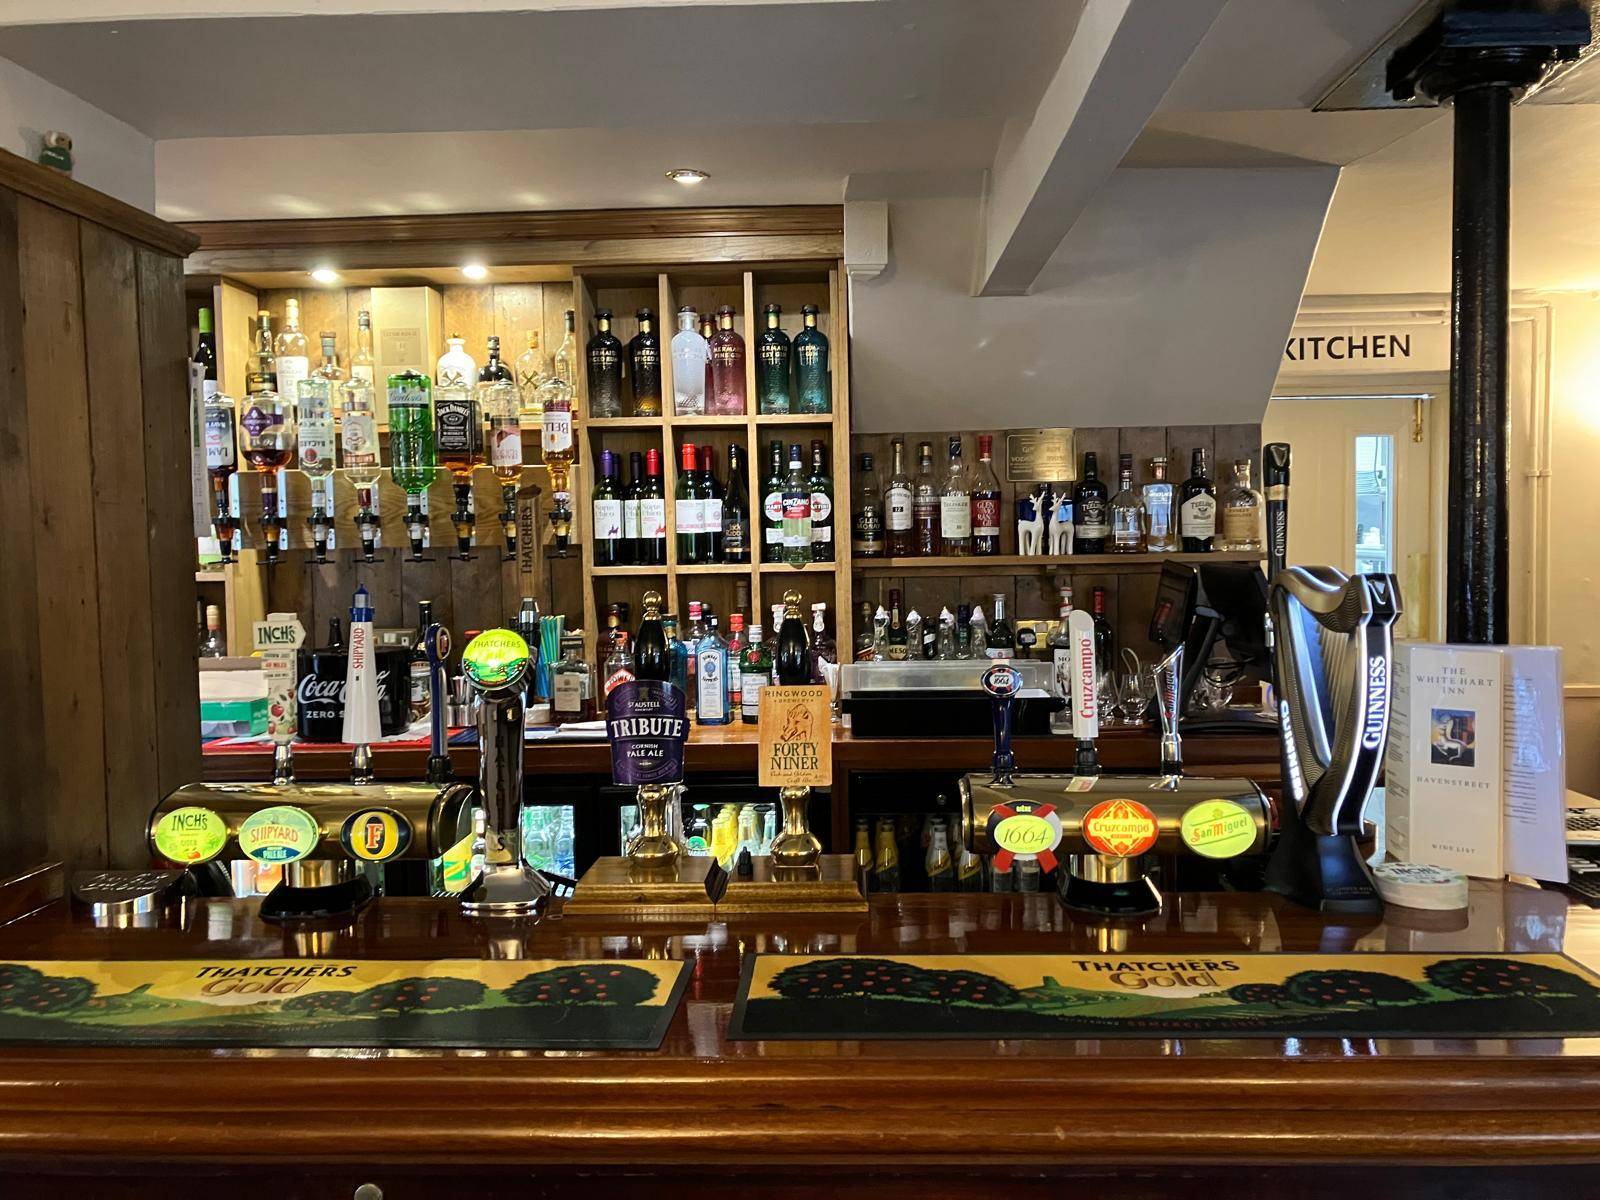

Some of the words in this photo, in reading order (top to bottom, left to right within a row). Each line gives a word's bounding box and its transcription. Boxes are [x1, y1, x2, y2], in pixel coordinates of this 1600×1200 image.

[1285, 334, 1410, 360] KITCHEN
[782, 498, 809, 506] CINZANO
[976, 501, 995, 509] GLEN
[521, 506, 533, 575] THATCHERS
[1274, 510, 1285, 557] GUINNESS
[353, 627, 365, 670] SHIPYARD
[473, 639, 521, 649] THATCHERS
[1441, 666, 1467, 676] THE
[1080, 639, 1095, 719] Cruzcampo
[1416, 675, 1459, 685] WHITE
[1460, 677, 1496, 688] HART
[1441, 686, 1466, 695] INN
[1362, 655, 1386, 751] GUINNESS
[306, 711, 335, 719] ZERO
[610, 718, 683, 738] TRIBUTE
[626, 750, 646, 758] PALE
[647, 749, 664, 757] ALE
[773, 742, 819, 757] FORTY
[770, 756, 819, 770] NINER
[1416, 776, 1491, 790] HAVENSTREET
[171, 812, 209, 832] INCH'S
[1093, 822, 1150, 833] Cruzcampo
[250, 824, 299, 844] SHIPYARD
[1003, 825, 1049, 845] 1664
[1431, 843, 1455, 851] WINE
[1456, 846, 1477, 855] LIST
[196, 965, 358, 978] THATCHERS
[1072, 959, 1241, 972] THATCHERS
[200, 977, 312, 997] Gold
[1109, 971, 1220, 990] Gold
